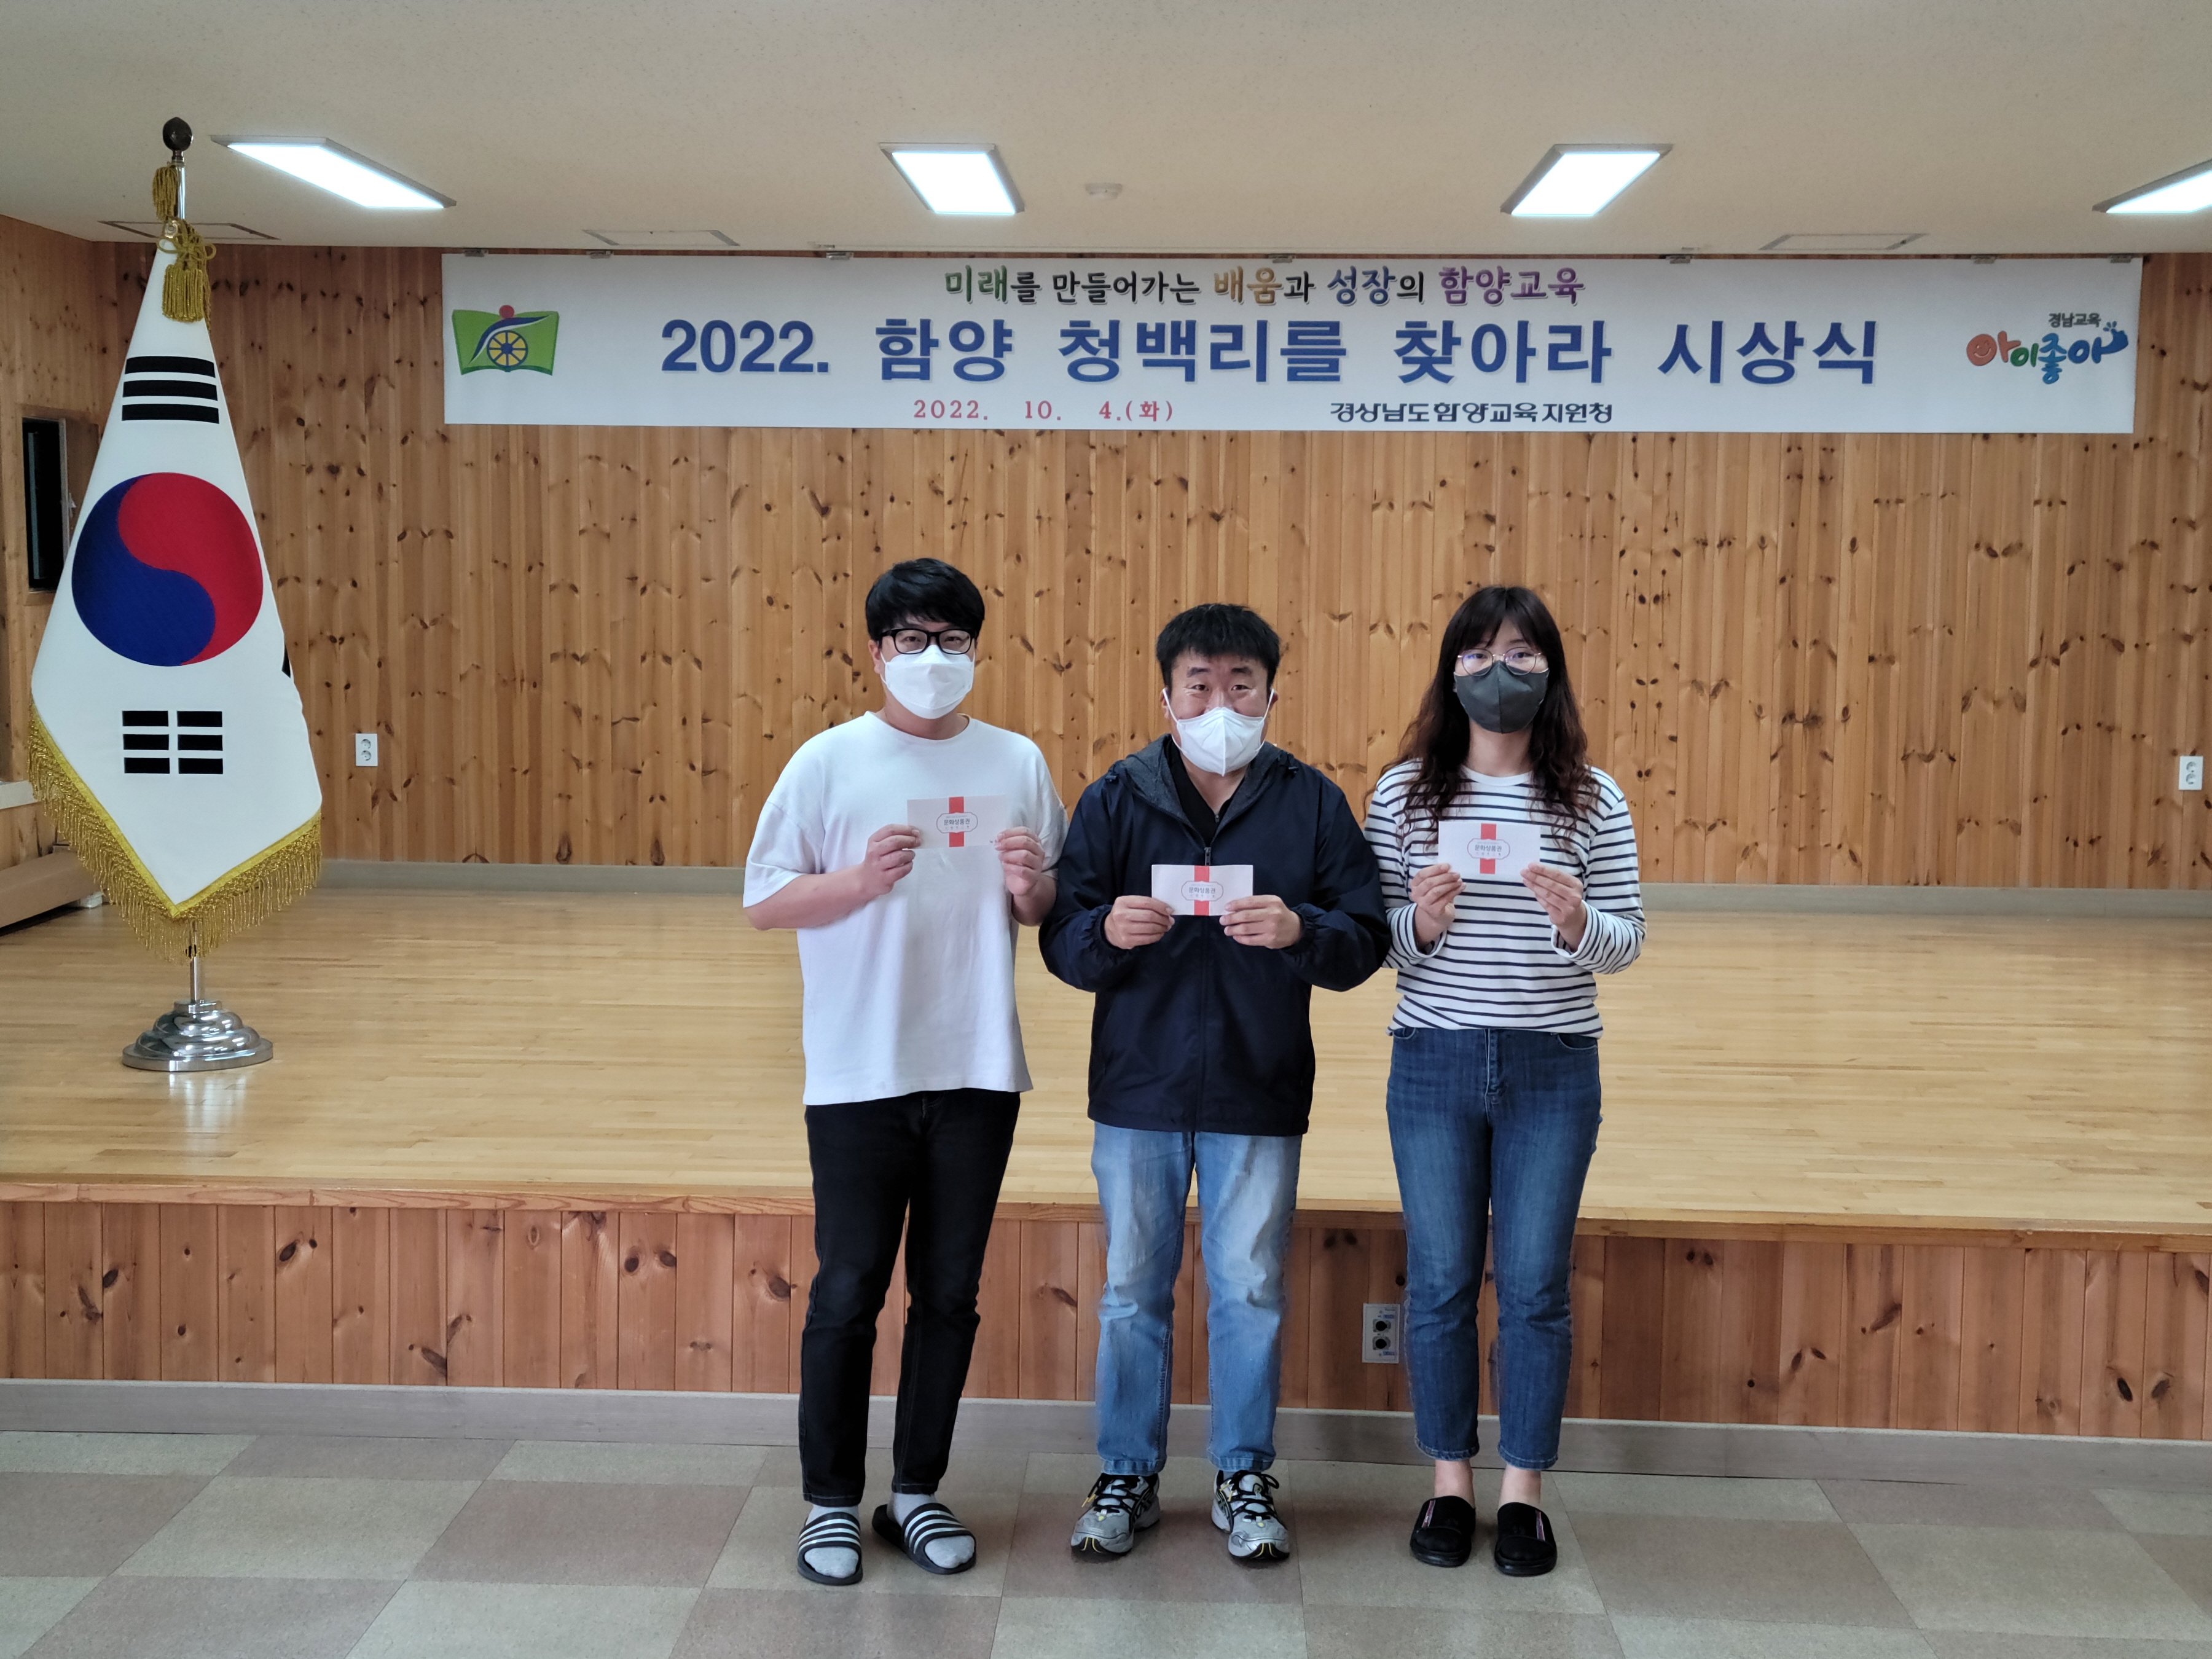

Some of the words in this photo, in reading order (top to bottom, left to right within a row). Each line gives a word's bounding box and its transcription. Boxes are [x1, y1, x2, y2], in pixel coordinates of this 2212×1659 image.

[944, 265, 1041, 305] 미래를
[1053, 270, 1201, 305] 만들어가는
[1213, 265, 1316, 305] 배움과
[1327, 265, 1424, 306] 성장의
[1438, 266, 1585, 307] 함양교육
[2049, 313, 2101, 328] 경남교육
[661, 319, 830, 374] 2022.
[876, 319, 1014, 382] 함양
[1058, 319, 1347, 383] 청백리를
[1394, 320, 1612, 385] 찾아라
[1657, 321, 1877, 386] 시상식
[1966, 329, 2129, 385] 아이좋아
[913, 399, 989, 421] 2022.
[1025, 400, 1062, 421] 10.
